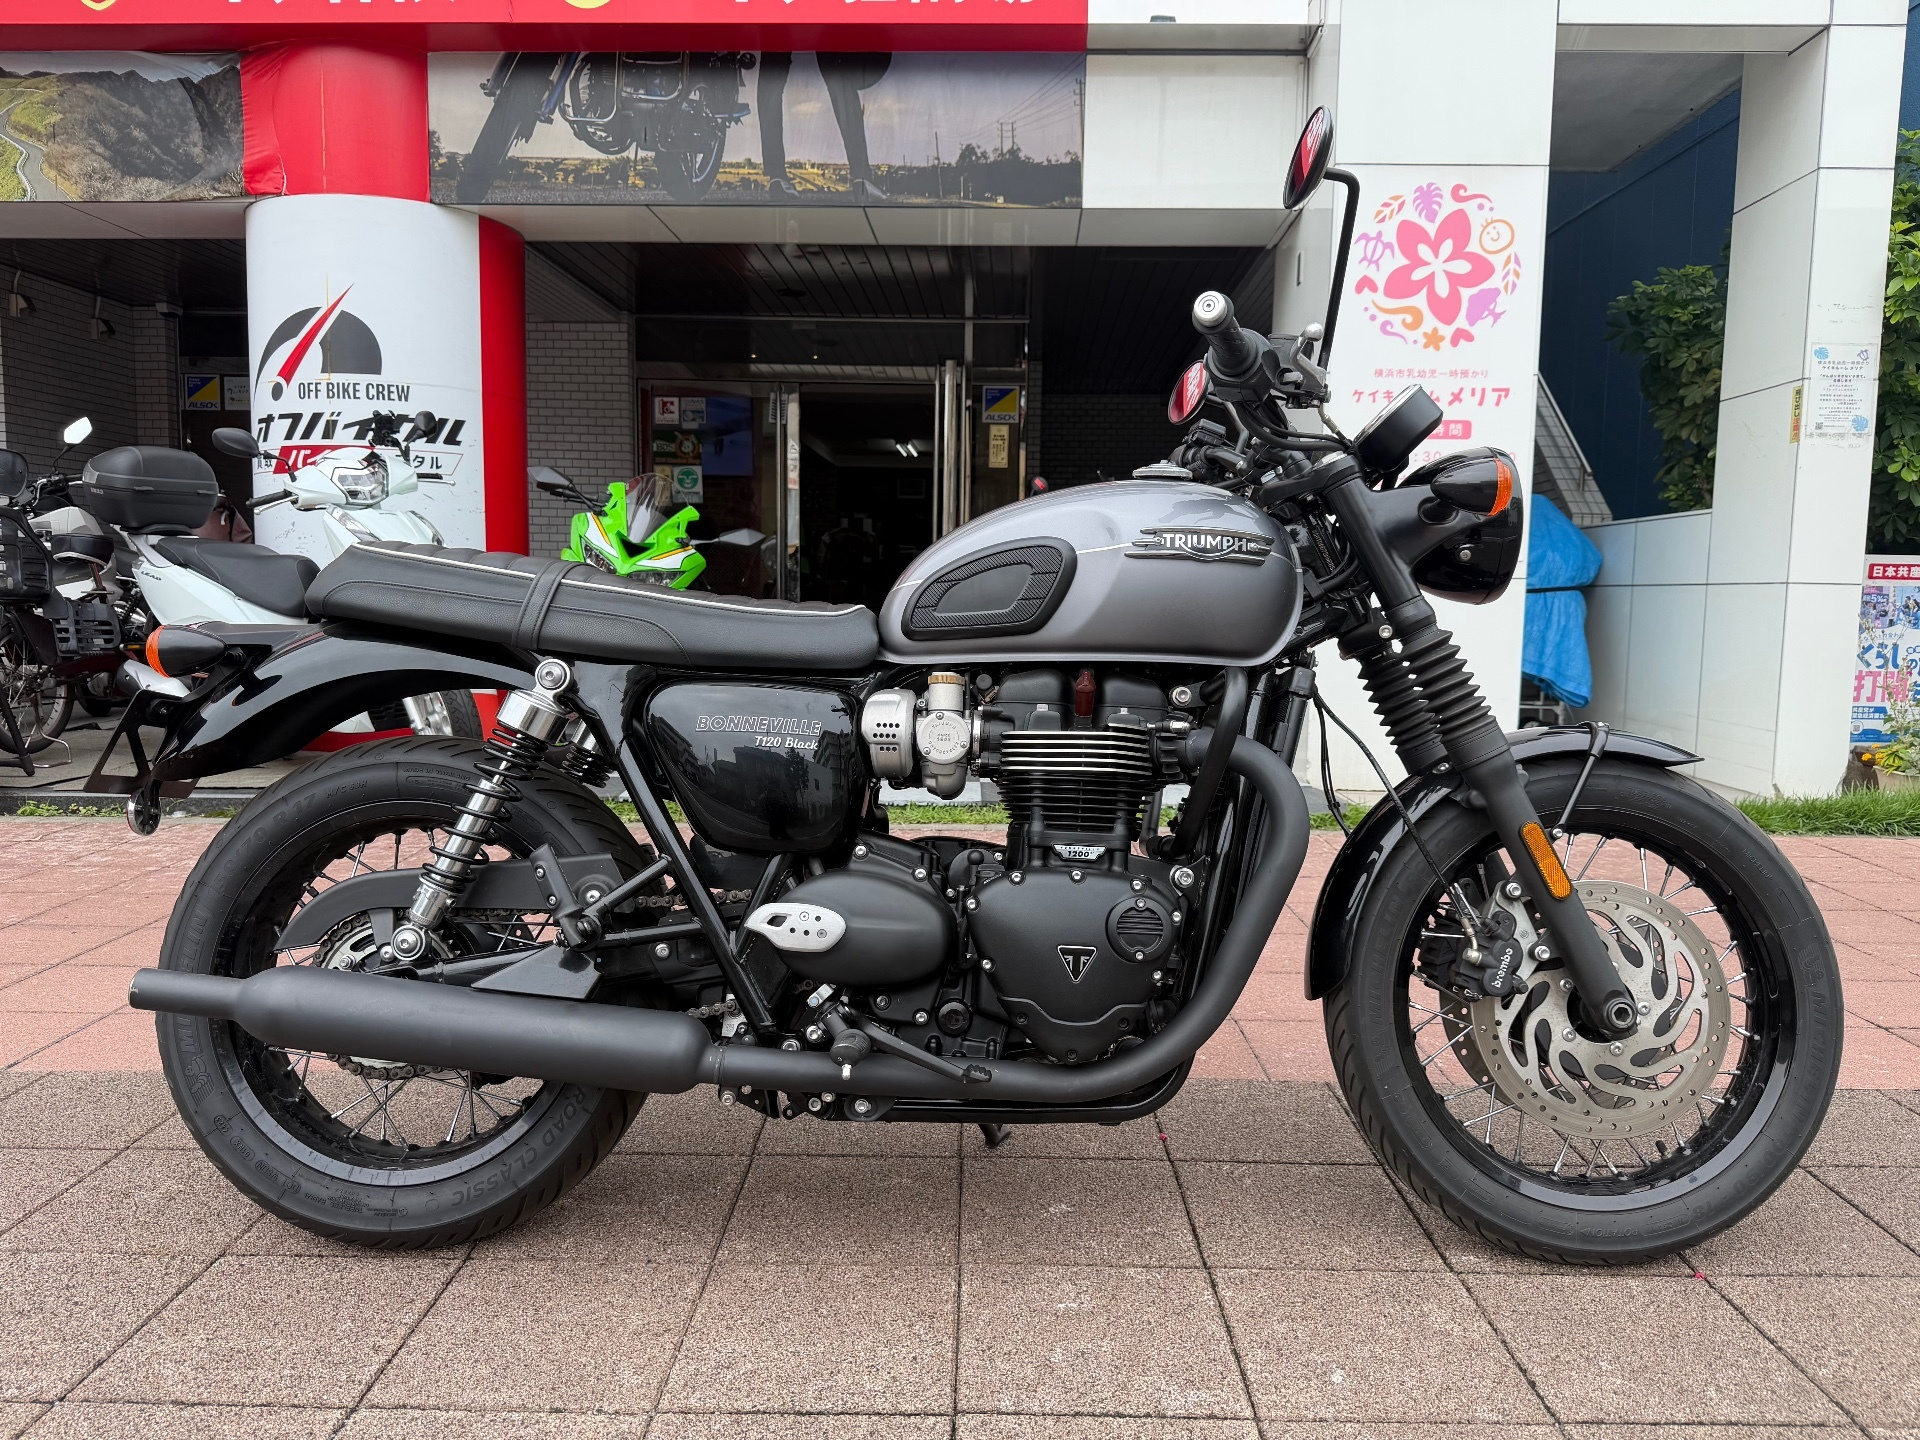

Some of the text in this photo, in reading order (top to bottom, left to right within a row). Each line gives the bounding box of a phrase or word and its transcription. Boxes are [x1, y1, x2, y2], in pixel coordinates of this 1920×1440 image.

[1374, 368, 1489, 379] 横浜市乳幼児一時預かり
[298, 381, 410, 402] OFF BIKE CREW
[1352, 387, 1511, 407] ケイキム メリア
[1162, 533, 1247, 552] TRIUMPH
[140, 571, 162, 581] LEAD
[695, 715, 822, 736] BONNEVILLE
[755, 735, 820, 750] T120 Black
[1491, 947, 1514, 989] brembo
[1792, 990, 1827, 1122] MICHELIN
[451, 1087, 587, 1207] ROAD CLASSIC
[1588, 1226, 1638, 1238] ROTATION
